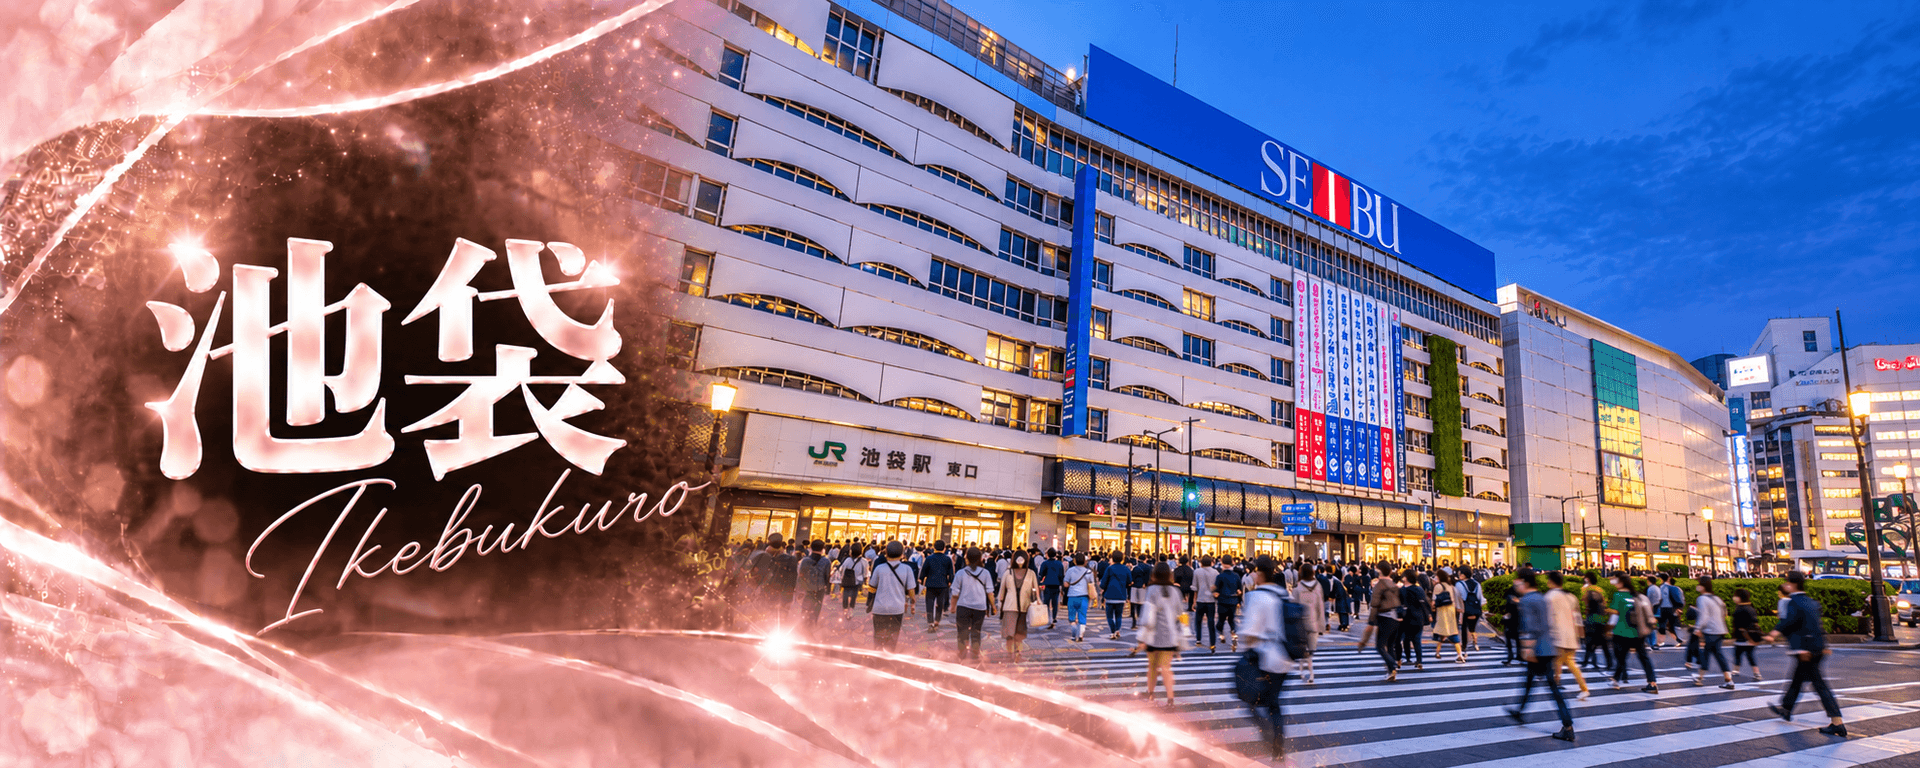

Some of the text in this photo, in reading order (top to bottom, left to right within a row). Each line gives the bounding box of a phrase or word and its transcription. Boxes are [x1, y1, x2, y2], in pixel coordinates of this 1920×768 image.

[1261, 140, 1402, 254] SEIBU
[808, 440, 847, 462] JR
[860, 446, 979, 480] 池袋駅 東口
